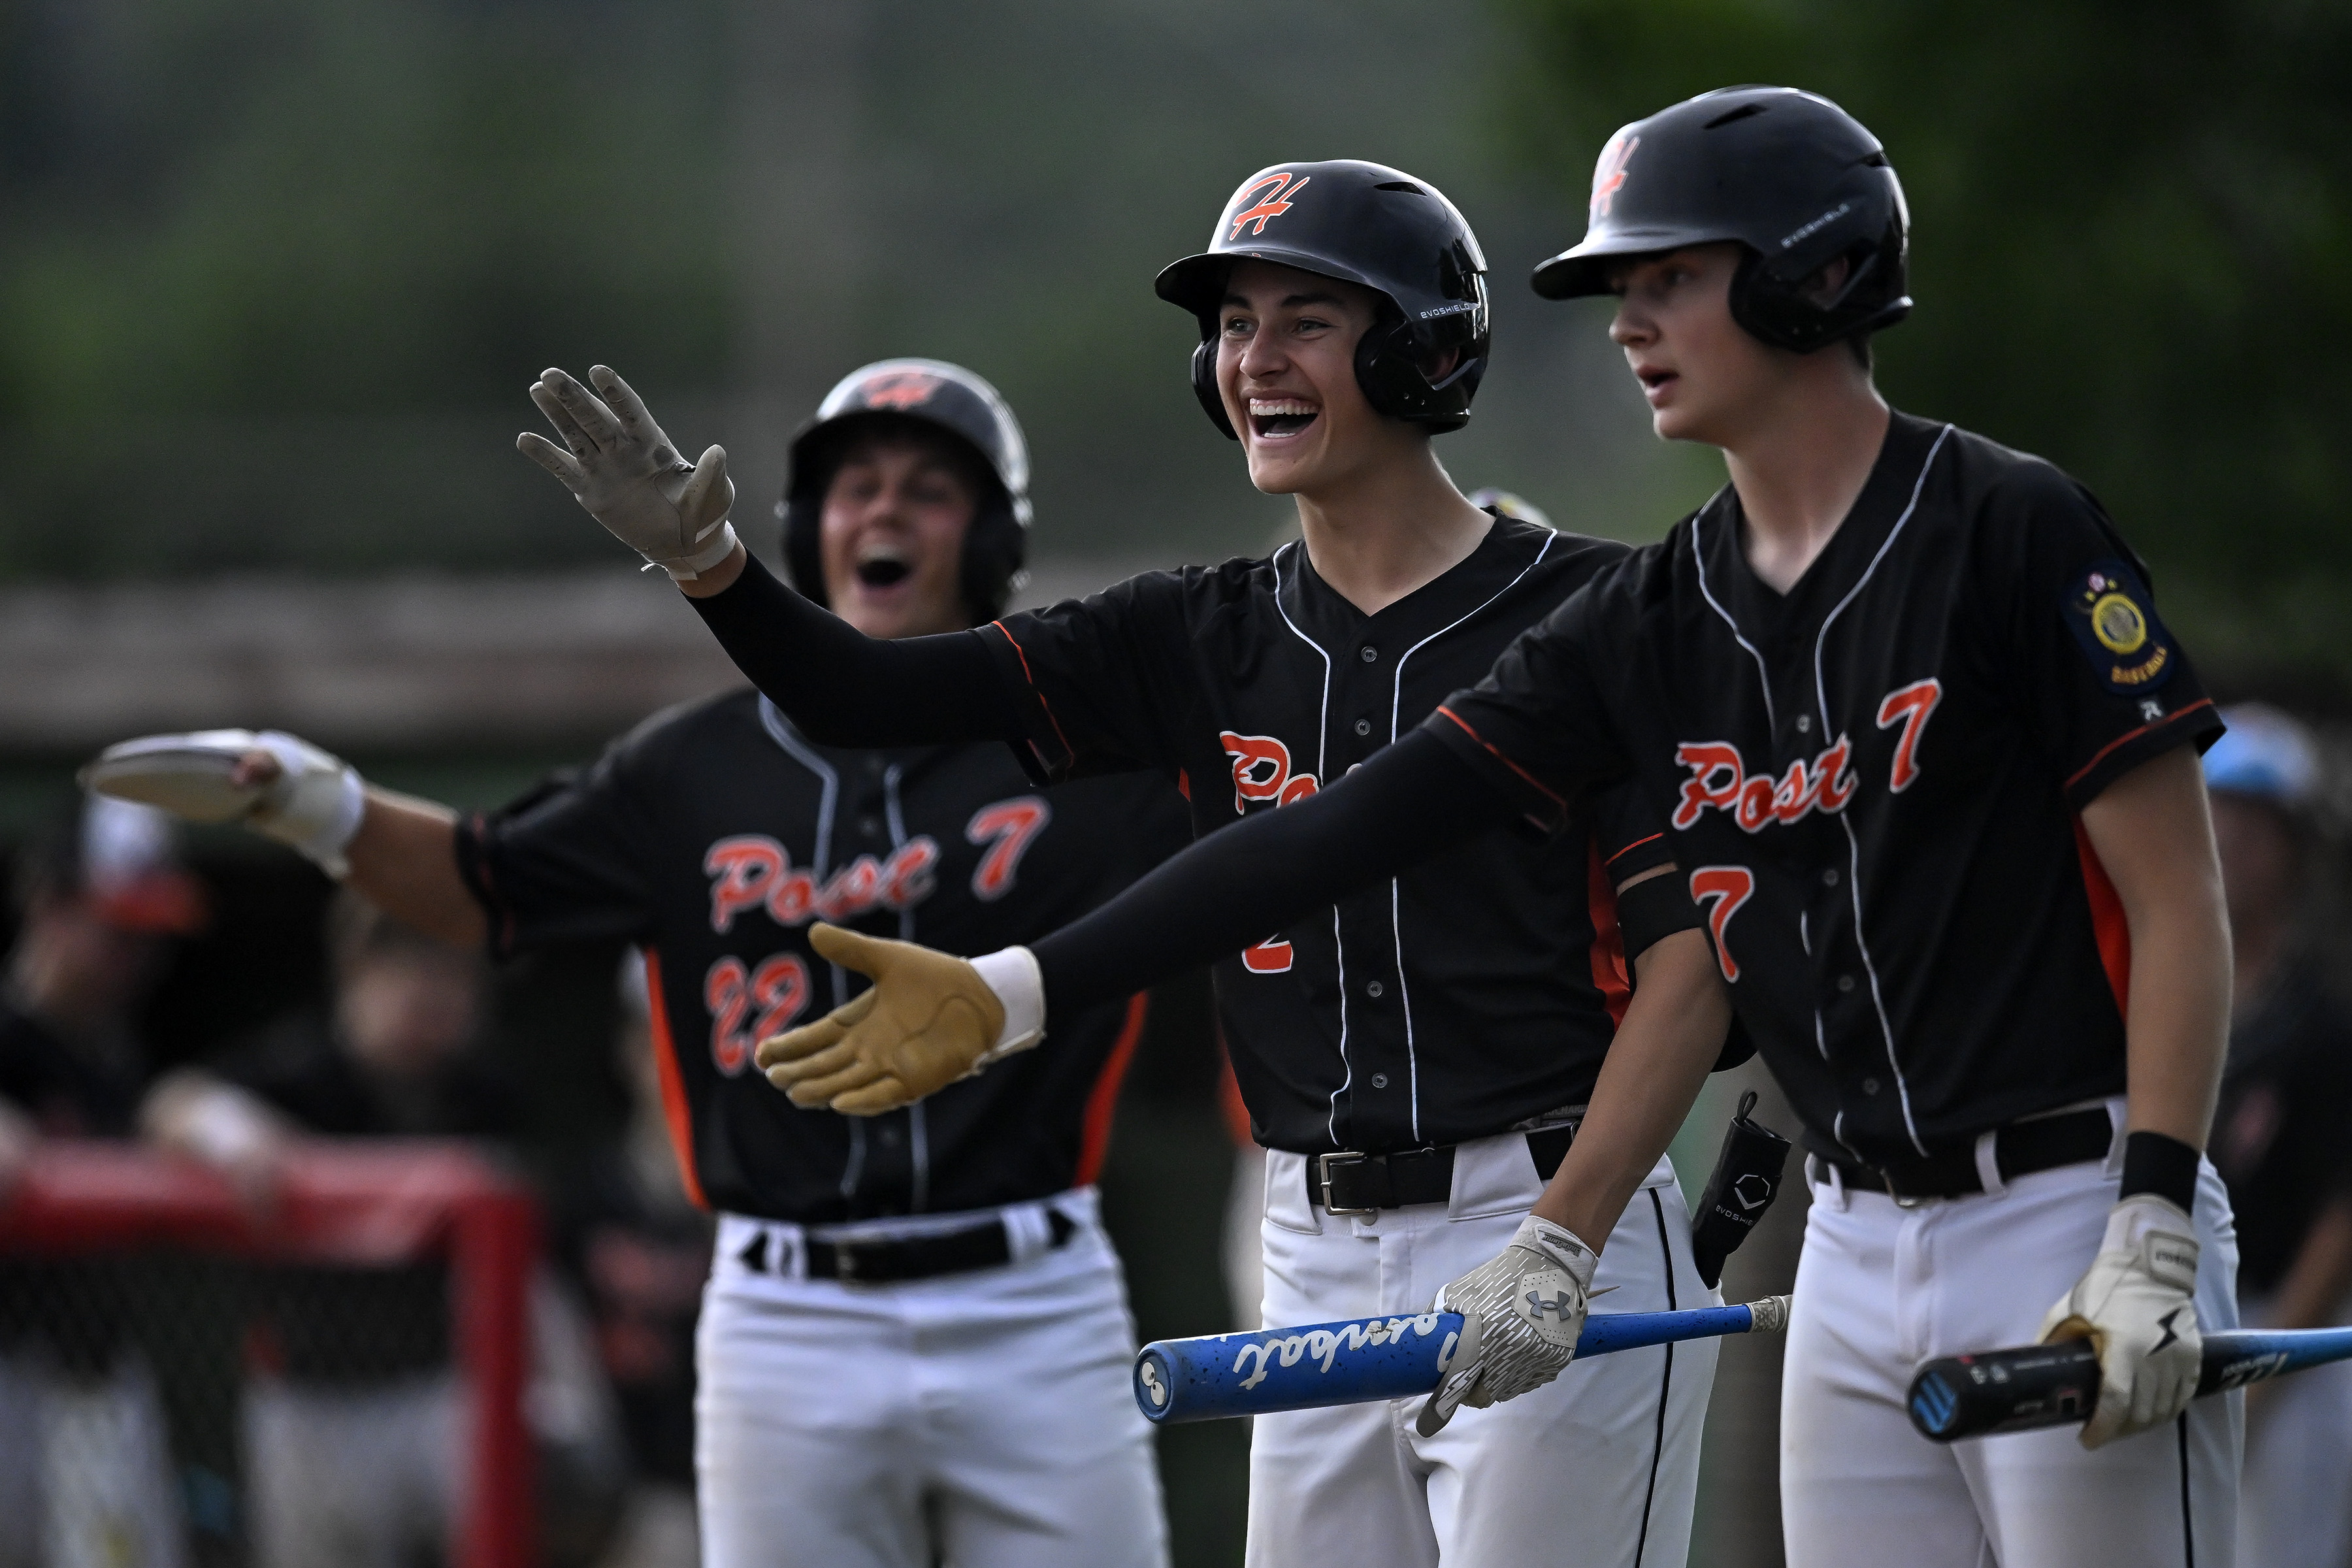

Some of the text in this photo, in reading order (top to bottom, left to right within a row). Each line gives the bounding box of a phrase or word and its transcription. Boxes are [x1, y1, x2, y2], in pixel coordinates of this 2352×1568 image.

[1228, 172, 1311, 241] H
[1219, 730, 1320, 815] Po
[1671, 676, 1943, 834] Post 7
[702, 795, 1051, 934] Post 7
[1690, 865, 1755, 983] 7
[704, 955, 812, 1078] 22
[1715, 1204, 1757, 1227] EVOSHIE
